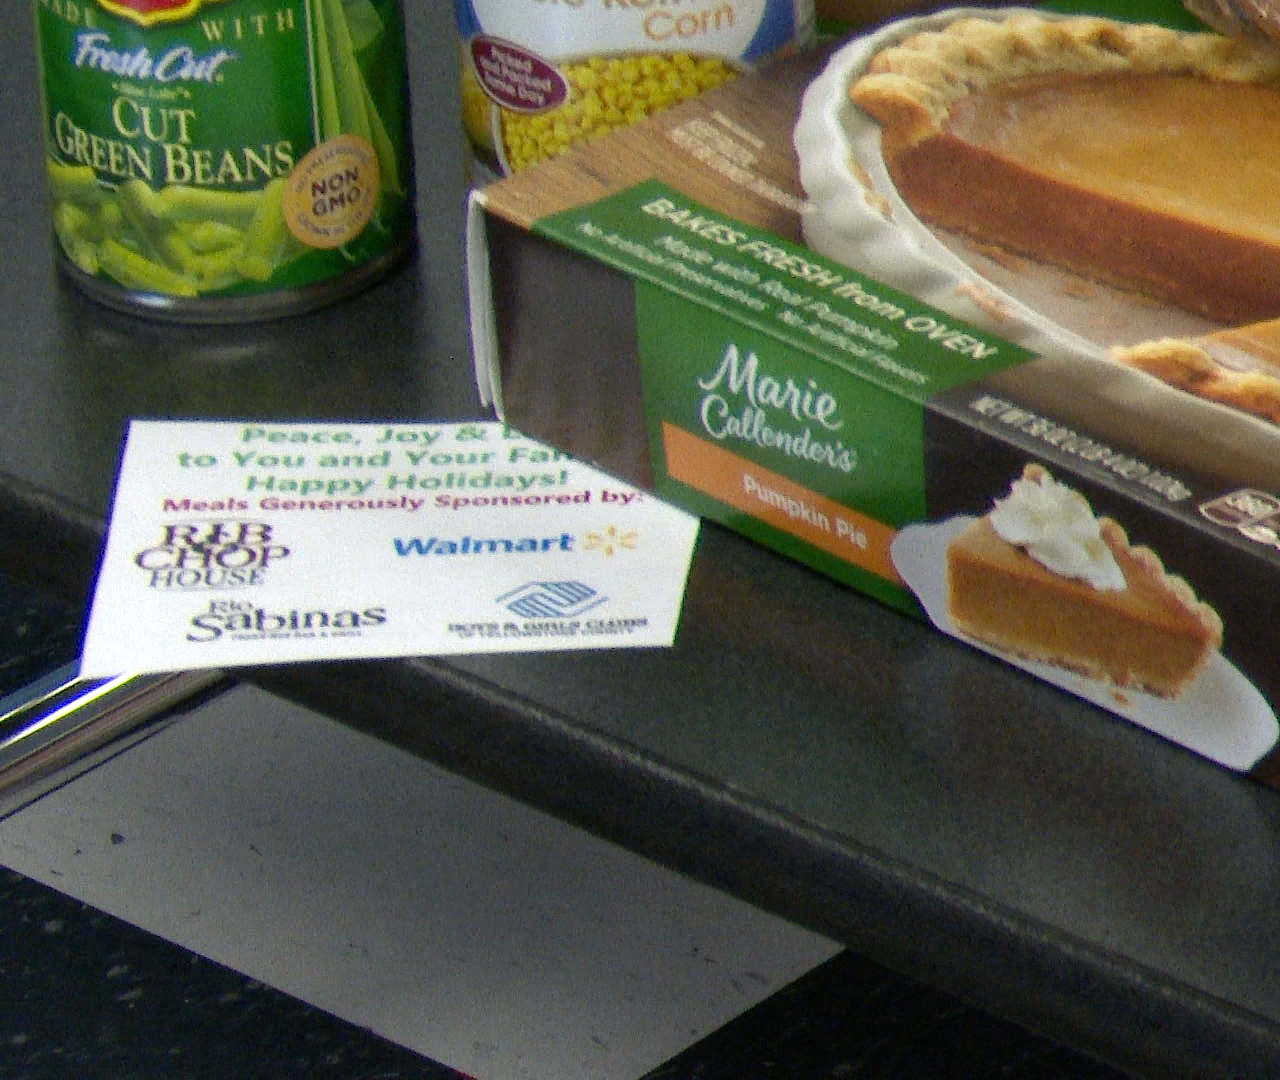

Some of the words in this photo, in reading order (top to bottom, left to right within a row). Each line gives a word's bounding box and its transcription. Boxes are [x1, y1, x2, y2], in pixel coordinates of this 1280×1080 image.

[201, 7, 294, 41] WITH
[643, 2, 735, 41] Corn
[74, 30, 151, 80] Fresh
[154, 45, 237, 83] Cut
[112, 95, 197, 145] CUT
[55, 111, 153, 182] GREEN
[164, 140, 295, 186] BEANS
[311, 166, 359, 198] NON
[311, 186, 361, 216] GMO
[641, 197, 747, 246] BAKES
[737, 239, 843, 288] FRESH
[832, 280, 906, 321] from
[904, 315, 999, 361] OVEN
[699, 343, 843, 430] Marie
[240, 426, 361, 446] Peace,
[376, 426, 441, 446] Joy
[455, 425, 487, 440] &
[700, 395, 859, 474] Callender's
[178, 451, 217, 468] to
[231, 450, 306, 468] You
[318, 449, 391, 468] and
[404, 449, 496, 466] Your
[244, 475, 374, 496] Happy
[386, 470, 568, 490] Holidays!
[162, 496, 250, 513] Meals
[259, 495, 424, 512] Generously
[435, 490, 592, 510] Sponsored
[601, 489, 644, 505] by:
[743, 471, 832, 534] Pumpkin
[835, 515, 868, 550] Pie
[133, 544, 292, 570] CHOP
[393, 531, 575, 557] Walmart
[148, 569, 268, 589] HOUSE
[185, 607, 388, 642] Sabinas
